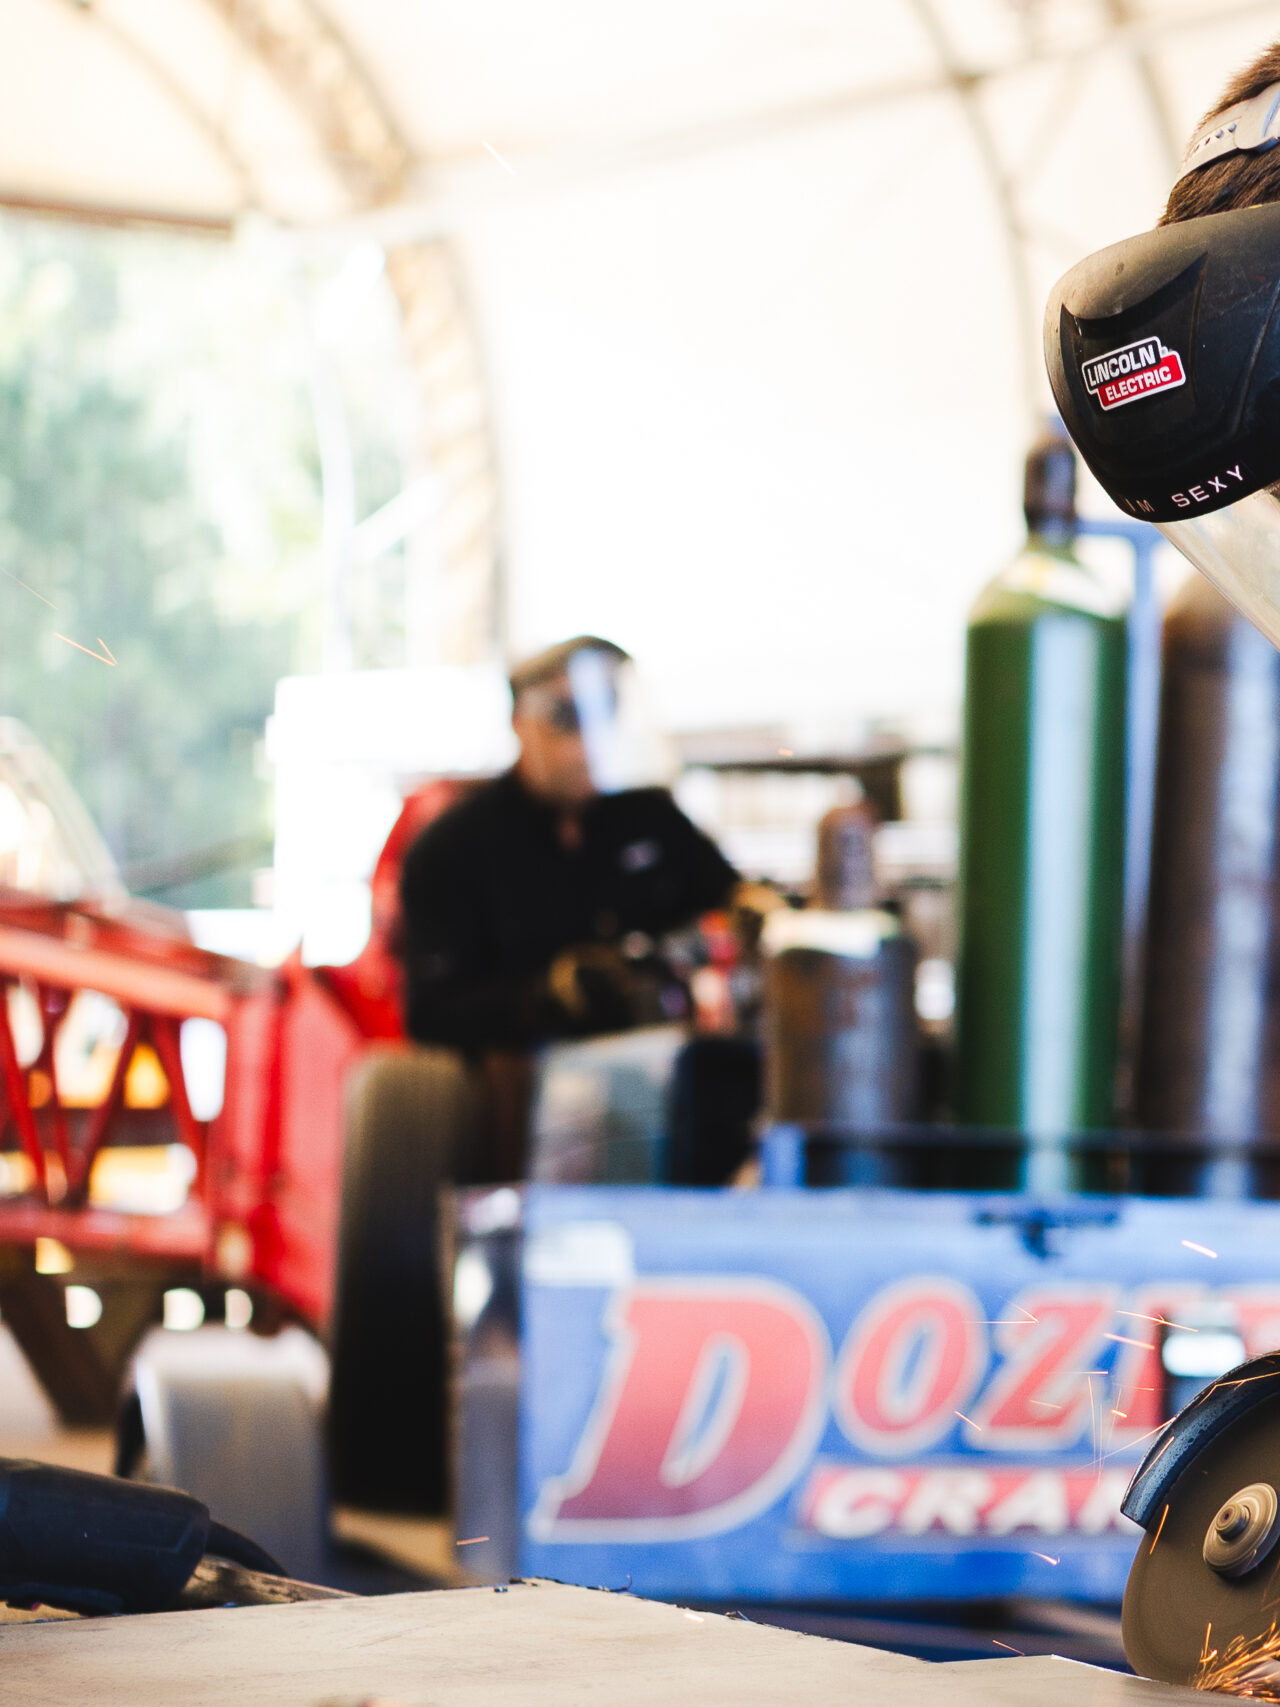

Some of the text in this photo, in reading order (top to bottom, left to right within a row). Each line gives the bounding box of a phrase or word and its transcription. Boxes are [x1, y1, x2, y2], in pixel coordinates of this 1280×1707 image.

[1087, 344, 1156, 387] LINCOLN
[1105, 366, 1172, 402] ELECTRIC
[1171, 464, 1244, 508] SEXY
